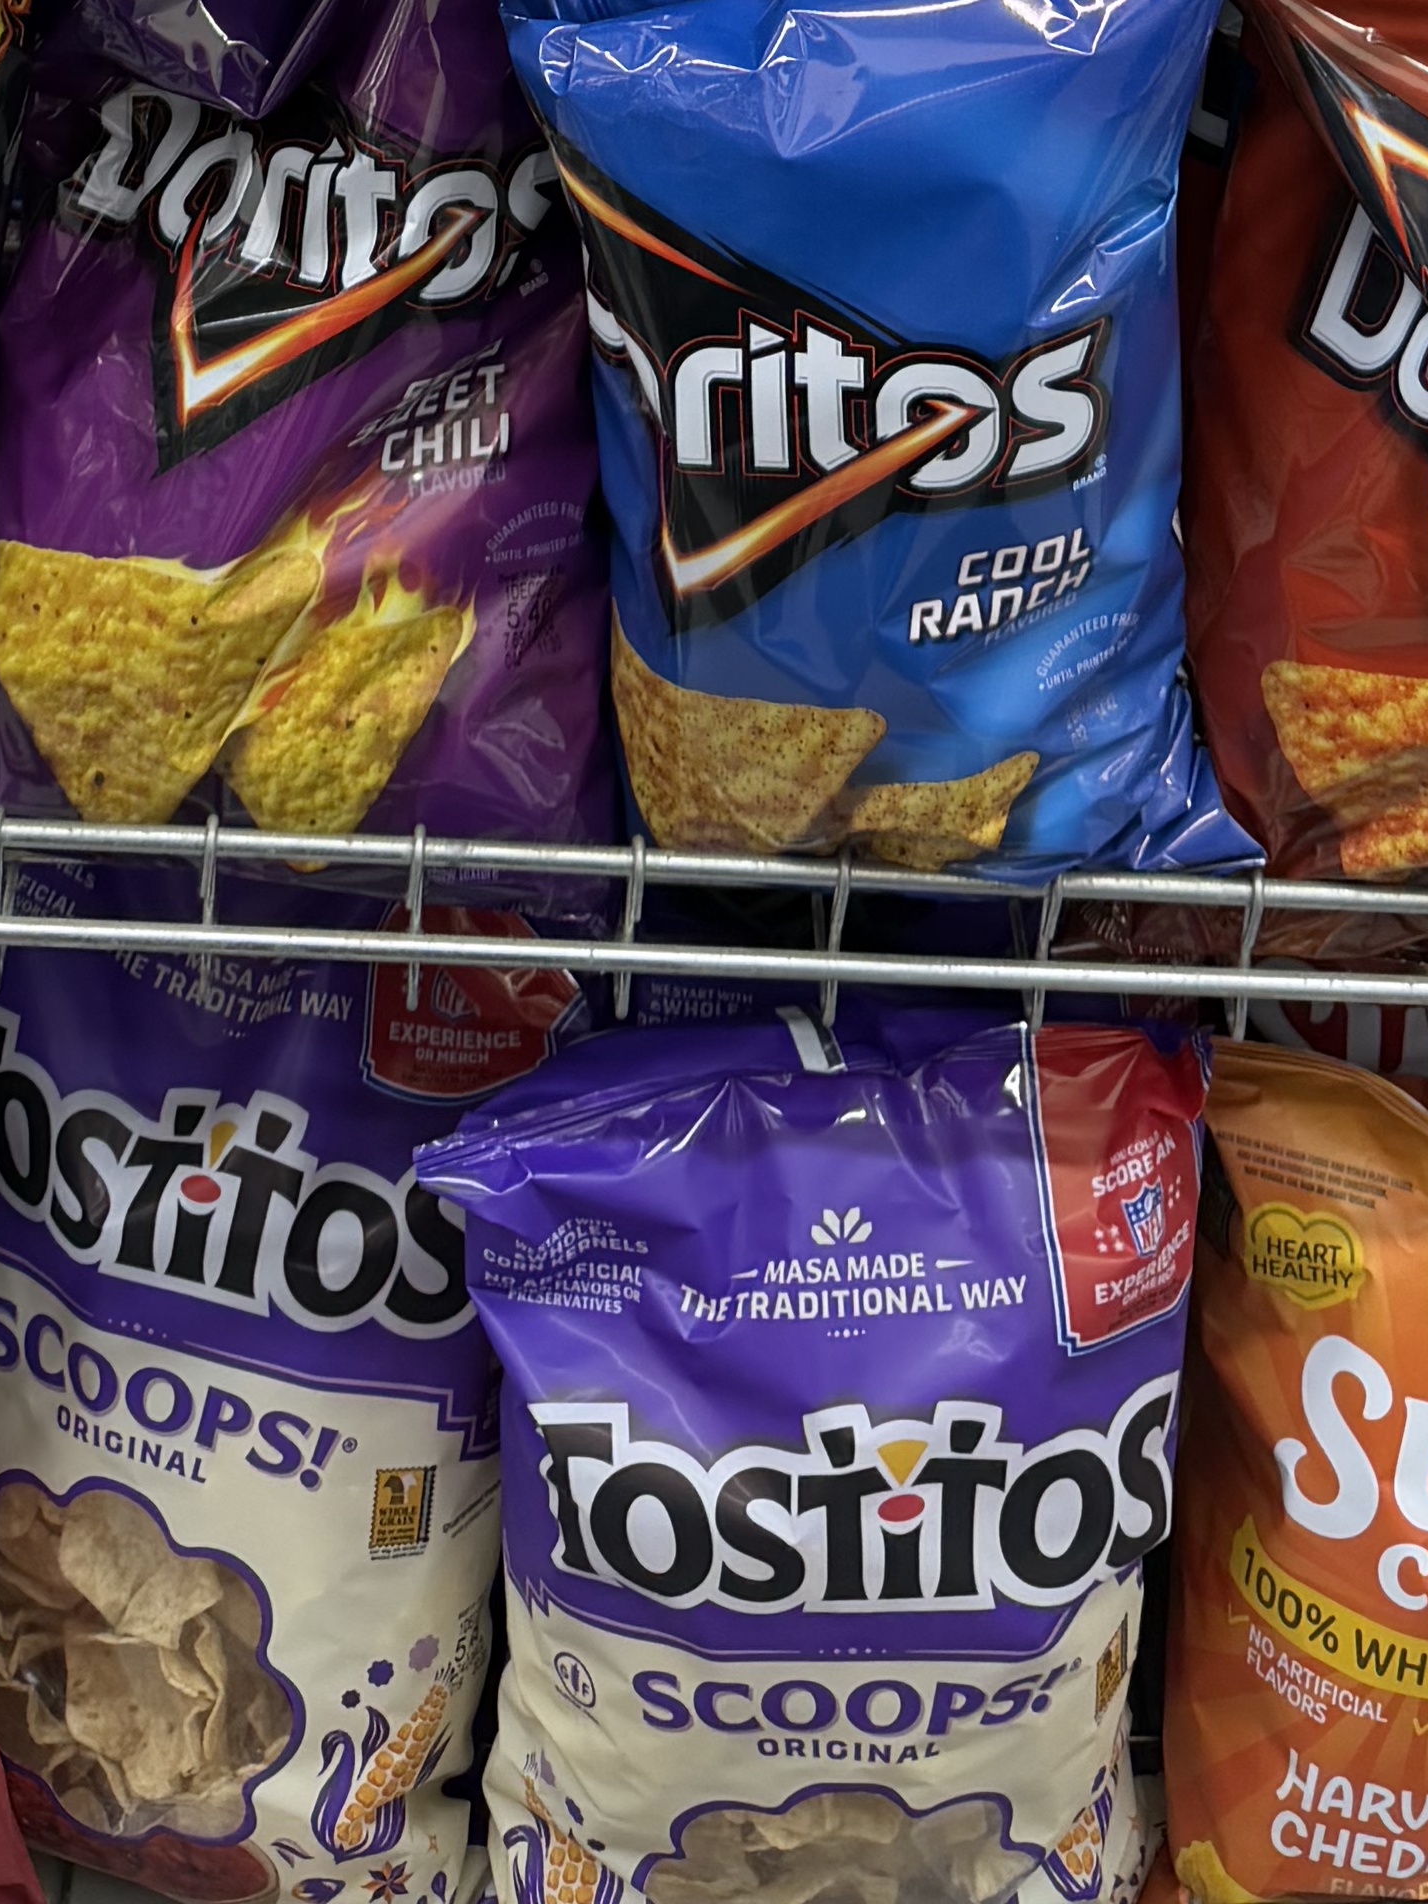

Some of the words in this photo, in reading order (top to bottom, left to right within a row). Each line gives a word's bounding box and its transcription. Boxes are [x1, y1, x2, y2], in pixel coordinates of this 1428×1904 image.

[380, 430, 510, 473] CHILI
[958, 528, 1090, 586] COOL
[388, 1021, 520, 1053] EXPERIENCE
[764, 1256, 841, 1281] MASA
[846, 1253, 925, 1278] MADE
[1266, 1236, 1342, 1268] HEART
[1252, 1255, 1354, 1288] HEALTHY
[680, 1285, 728, 1321] THE
[734, 1283, 954, 1319] TRADITIONAL
[959, 1276, 1028, 1311] WAY
[1239, 1546, 1341, 1654] 100%
[632, 1665, 1057, 1735] SCOOPS!
[757, 1738, 941, 1763] ORIGINAL
